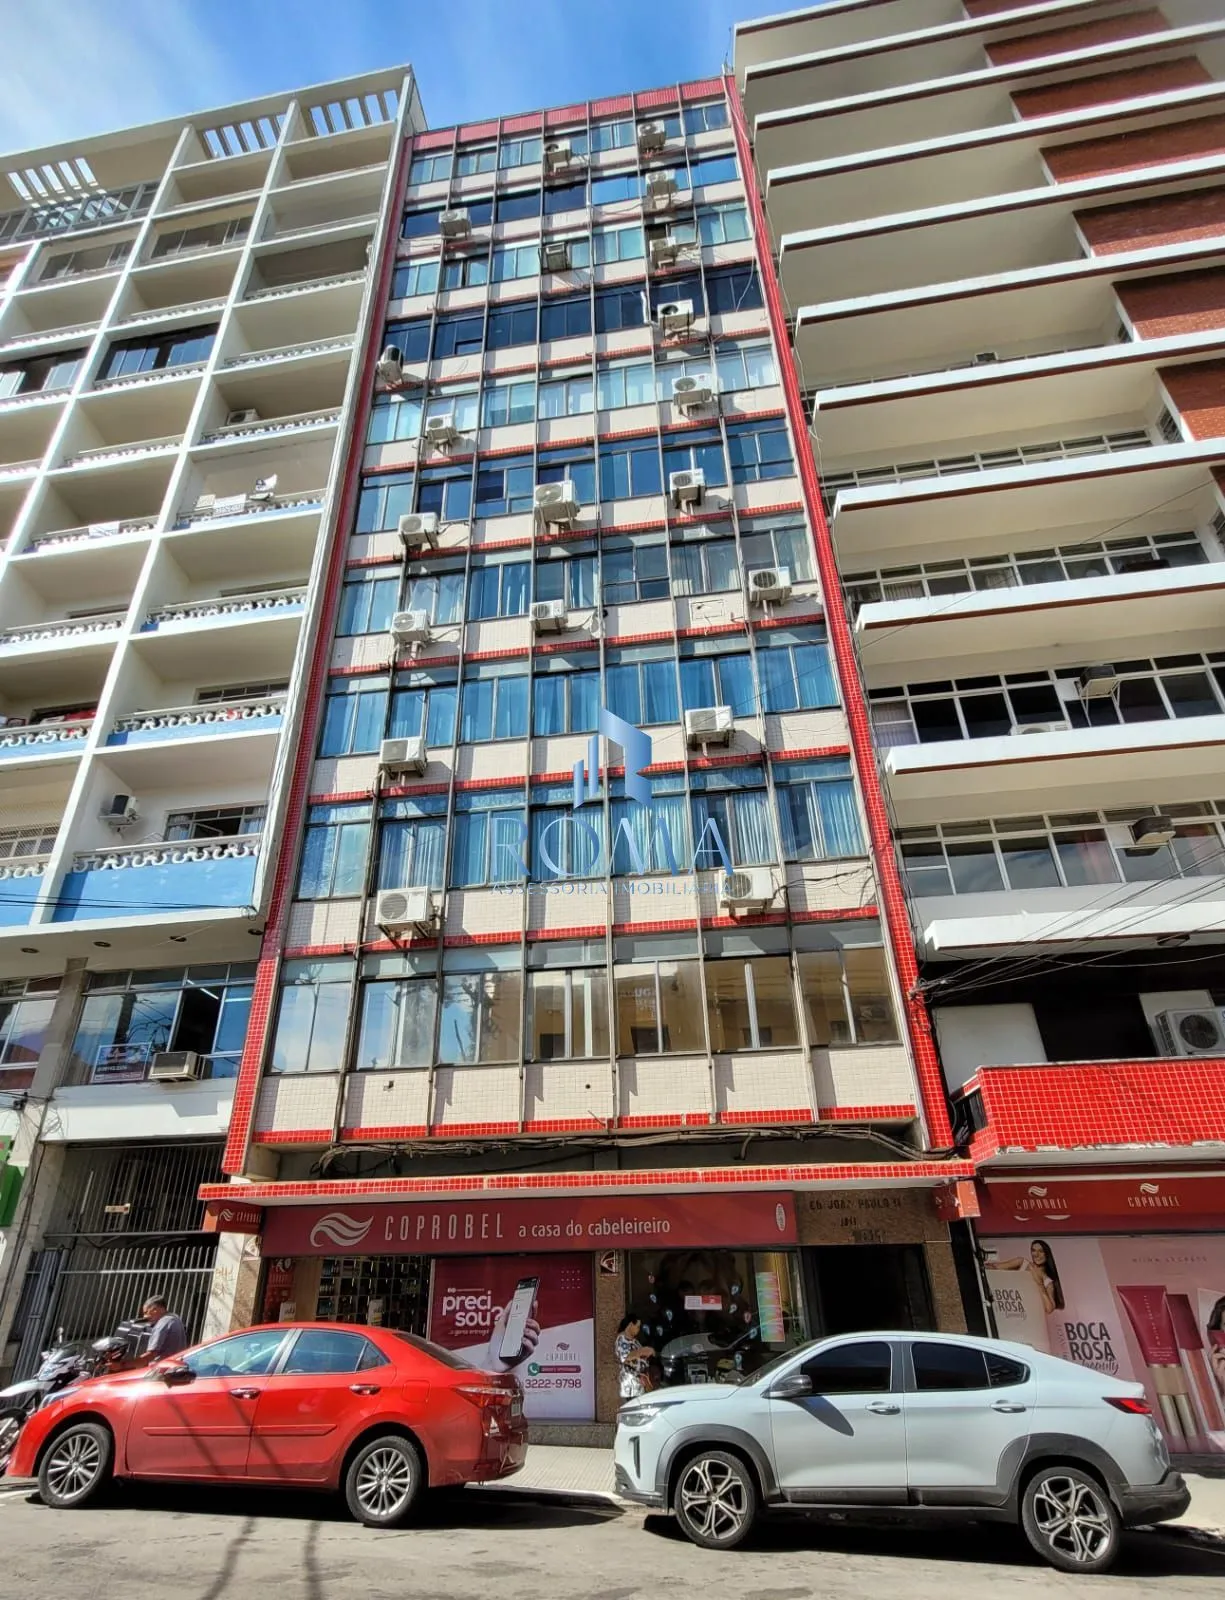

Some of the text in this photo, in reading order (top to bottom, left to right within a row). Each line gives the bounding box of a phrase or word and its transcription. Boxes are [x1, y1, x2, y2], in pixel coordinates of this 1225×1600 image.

[384, 1213, 671, 1241] COPROBEL a casa do cabeleireiro
[442, 1290, 492, 1316] preci
[995, 1288, 1022, 1301] BOCA
[997, 1300, 1025, 1312] ROSA
[1064, 1322, 1112, 1341] BOCA
[1069, 1341, 1117, 1361] ROSA
[525, 1378, 582, 1389] 3222-9798
